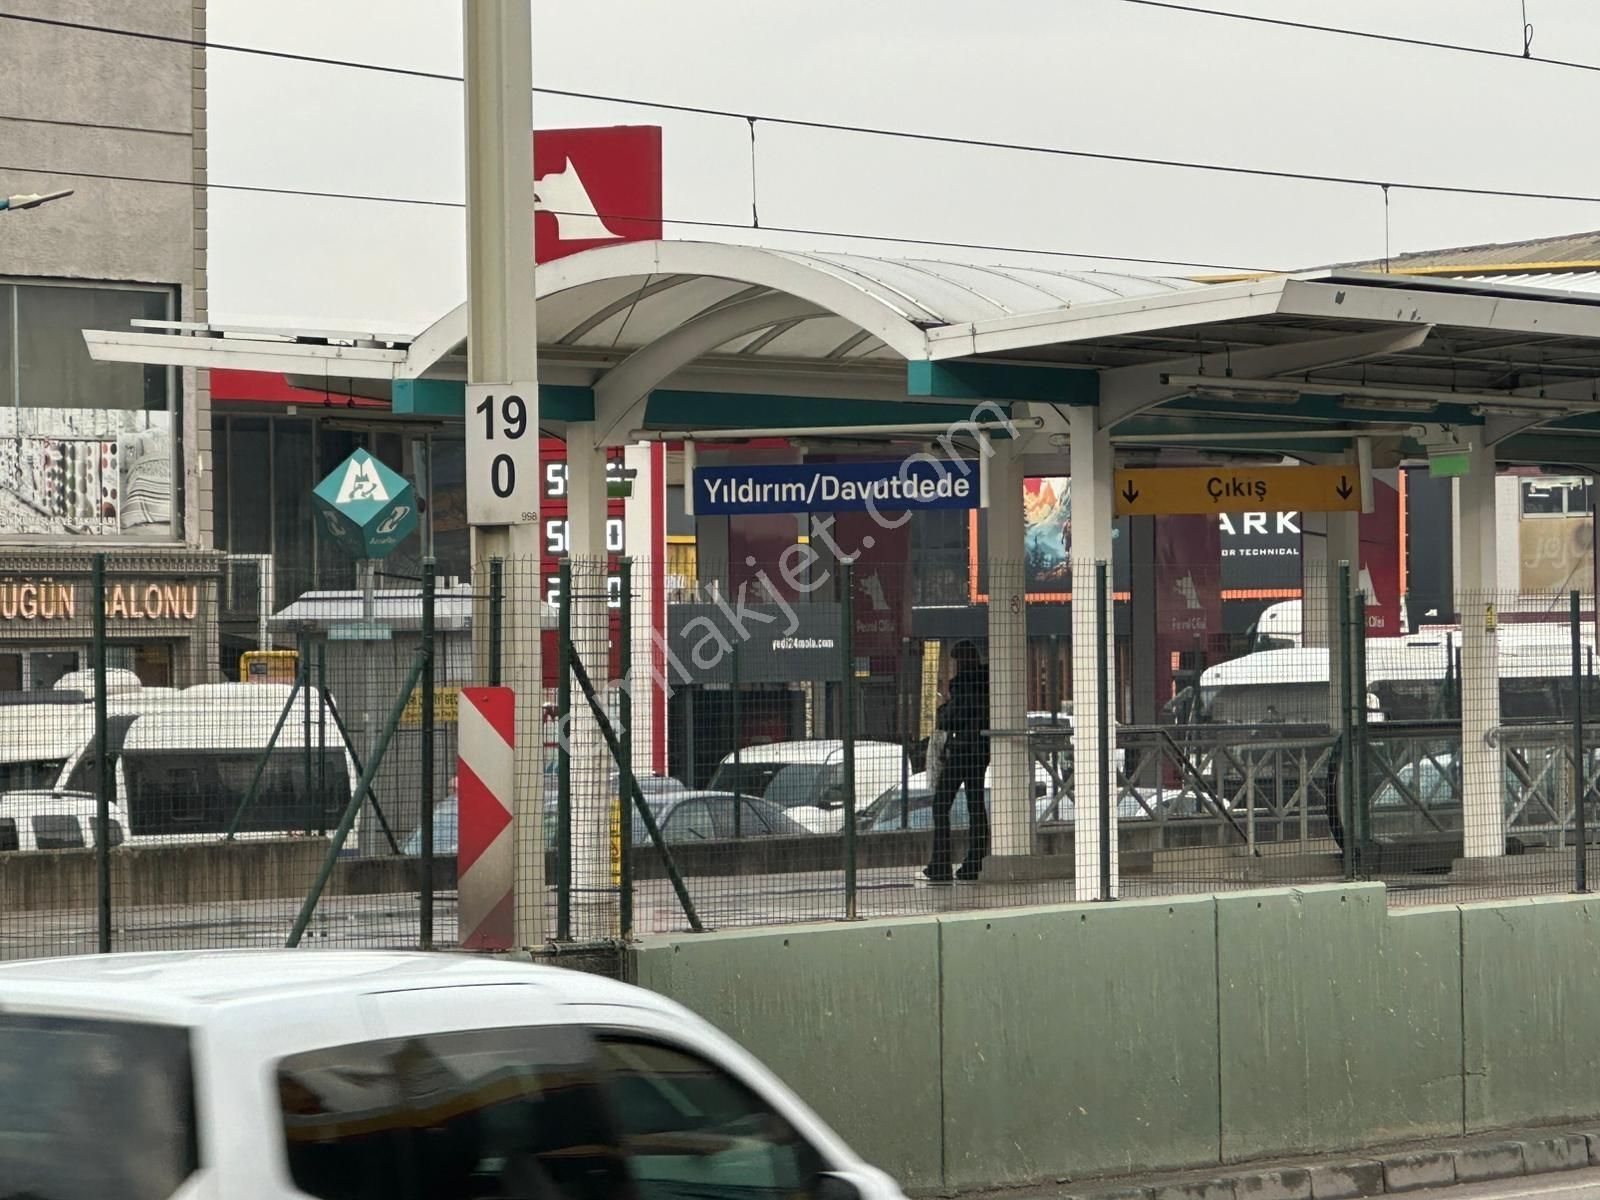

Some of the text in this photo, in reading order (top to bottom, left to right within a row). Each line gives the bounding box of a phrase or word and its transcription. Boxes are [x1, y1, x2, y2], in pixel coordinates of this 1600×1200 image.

[476, 394, 527, 441] 19
[491, 453, 516, 498] 0
[704, 474, 970, 503] Yıldırım/Davutdede
[1207, 477, 1267, 503] Çıkış
[1239, 548, 1299, 556] TECHNICAL
[104, 583, 197, 619] ALONU
